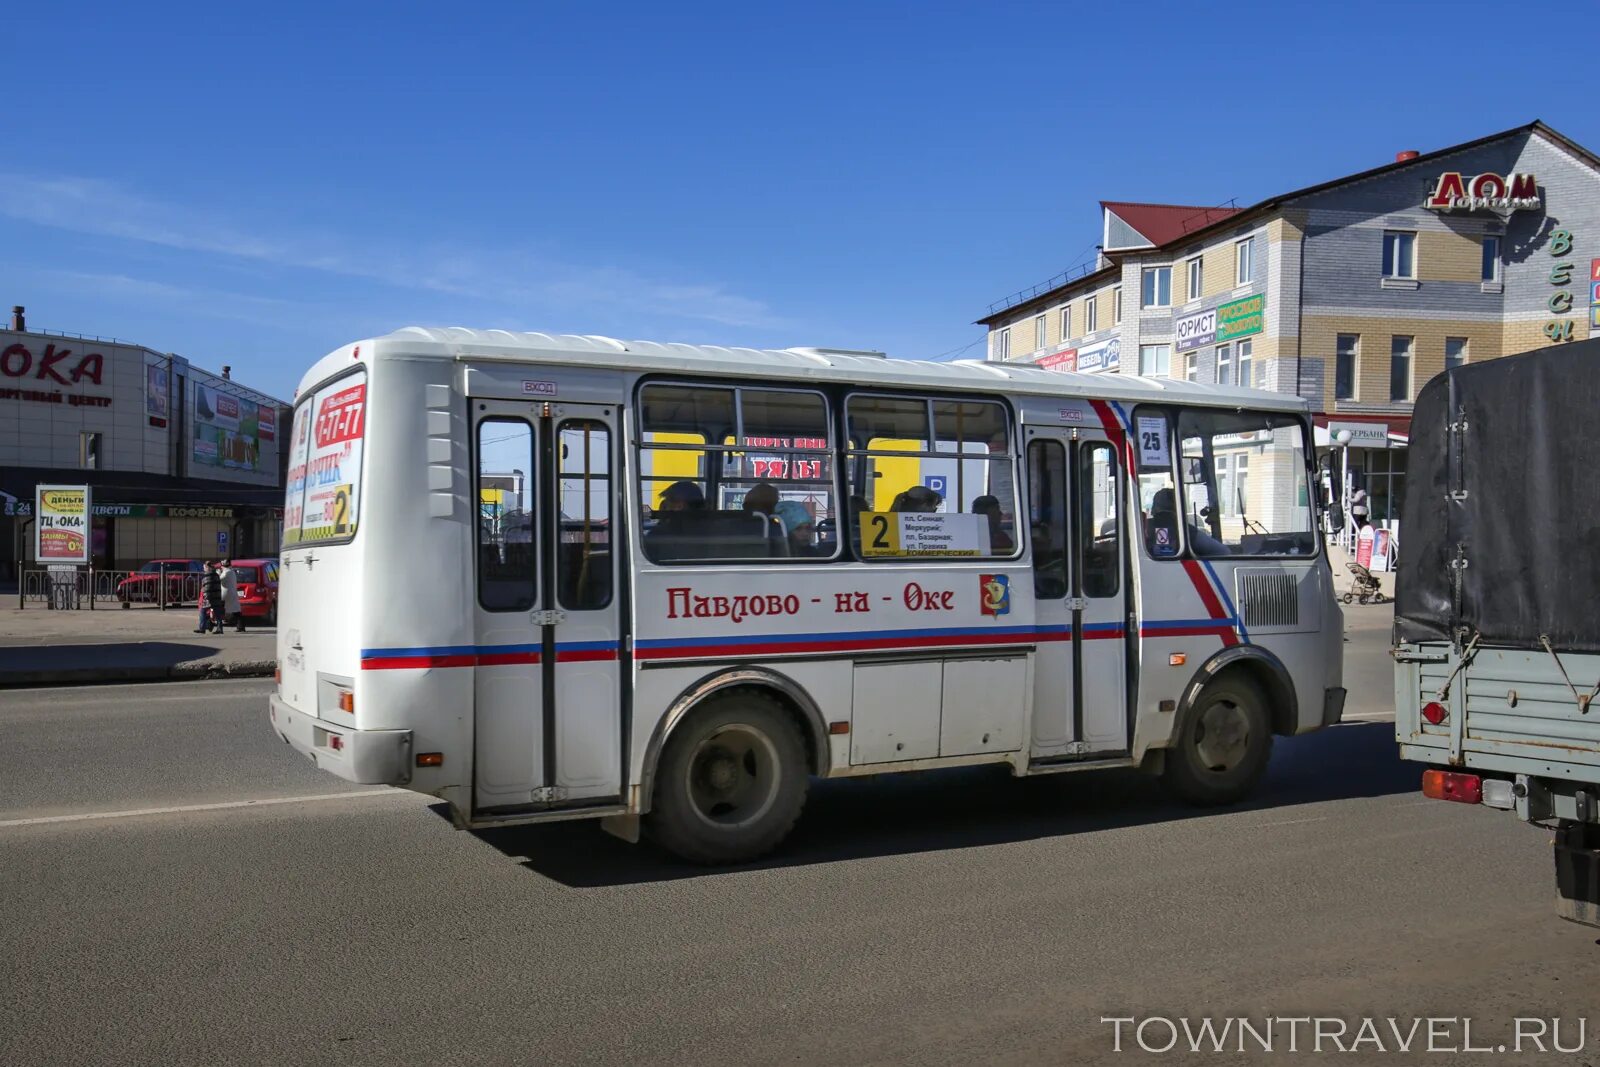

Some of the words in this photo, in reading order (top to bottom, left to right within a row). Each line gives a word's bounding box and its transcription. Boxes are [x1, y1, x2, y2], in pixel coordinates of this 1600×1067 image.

[1425, 172, 1539, 208] ДОМ
[1178, 314, 1214, 338] ЮРИСТ
[1, 343, 104, 385] ОКА
[525, 382, 555, 393] ВХОД
[1142, 432, 1160, 451] 25
[1349, 429, 1385, 439] БЕРБАНК
[51, 496, 84, 504] ДЕНЬГИ
[41, 516, 53, 528] ТЦ
[168, 505, 233, 518] КОФЕЙНЯ
[335, 490, 347, 533] 2
[871, 515, 890, 548] 2
[666, 587, 800, 624] Павлово
[834, 591, 870, 613] на
[904, 582, 954, 612] Оке
